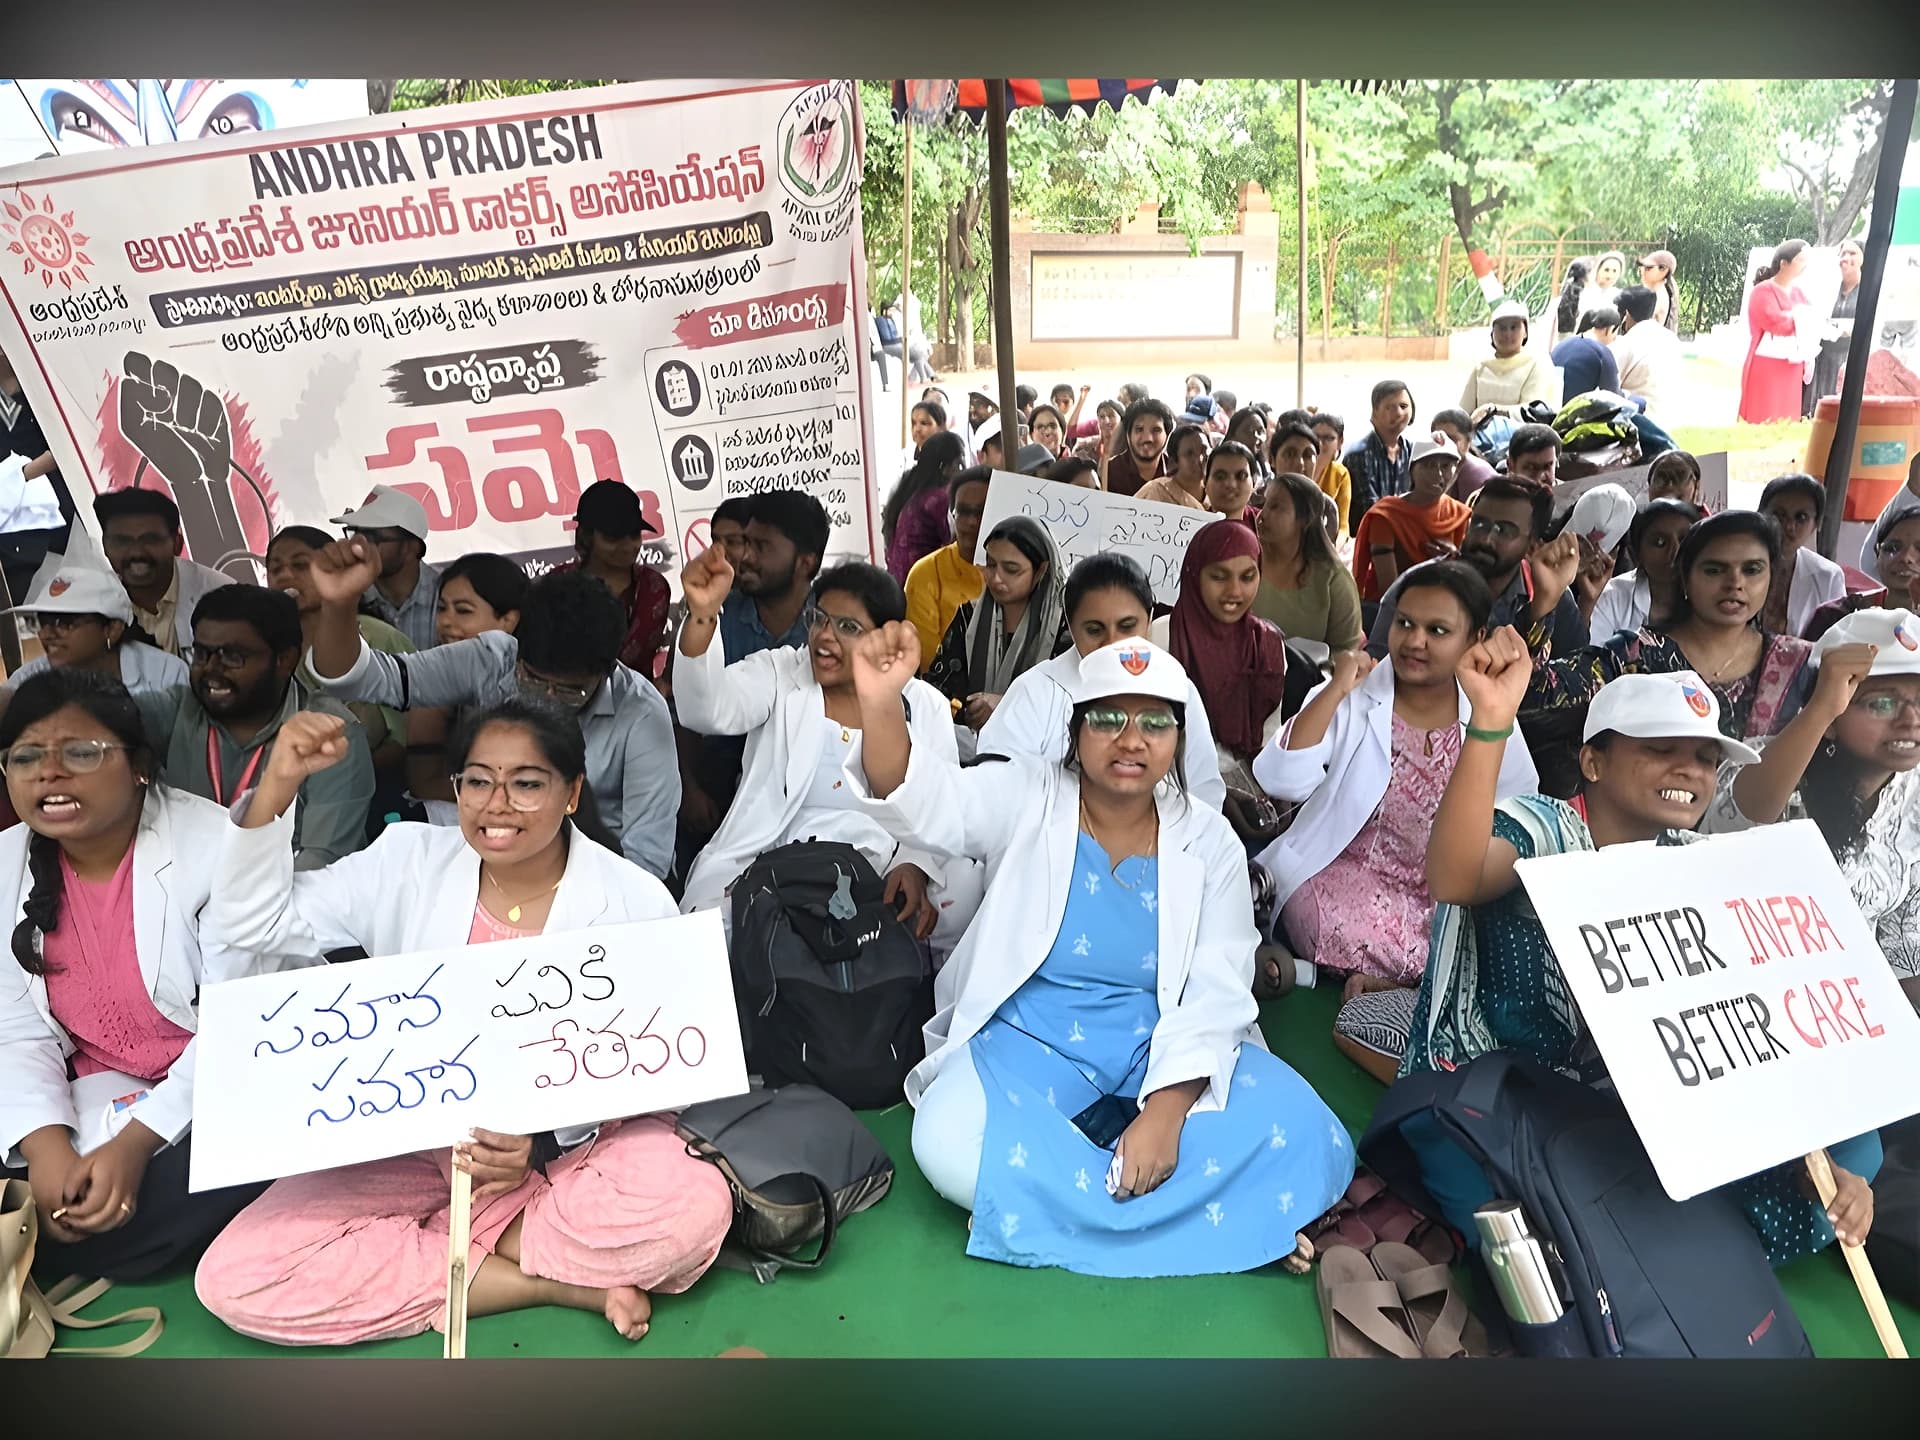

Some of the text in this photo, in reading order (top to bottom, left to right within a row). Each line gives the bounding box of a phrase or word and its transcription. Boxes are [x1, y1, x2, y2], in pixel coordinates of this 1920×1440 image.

[249, 113, 603, 200] ANDHRA PRADESH
[308, 187, 459, 250] జూనియర్
[462, 175, 567, 247] డాక్టర్స్
[569, 144, 765, 219] అసోసియేషన్
[593, 282, 607, 304] &
[624, 240, 637, 260] &
[708, 311, 742, 337] మా
[1578, 895, 1845, 994] BETTER INFRA
[254, 944, 615, 1057] సమాన పనికి
[1653, 977, 1885, 1087] BETTER CARE
[307, 1006, 707, 1127] సమాన వేతనం
